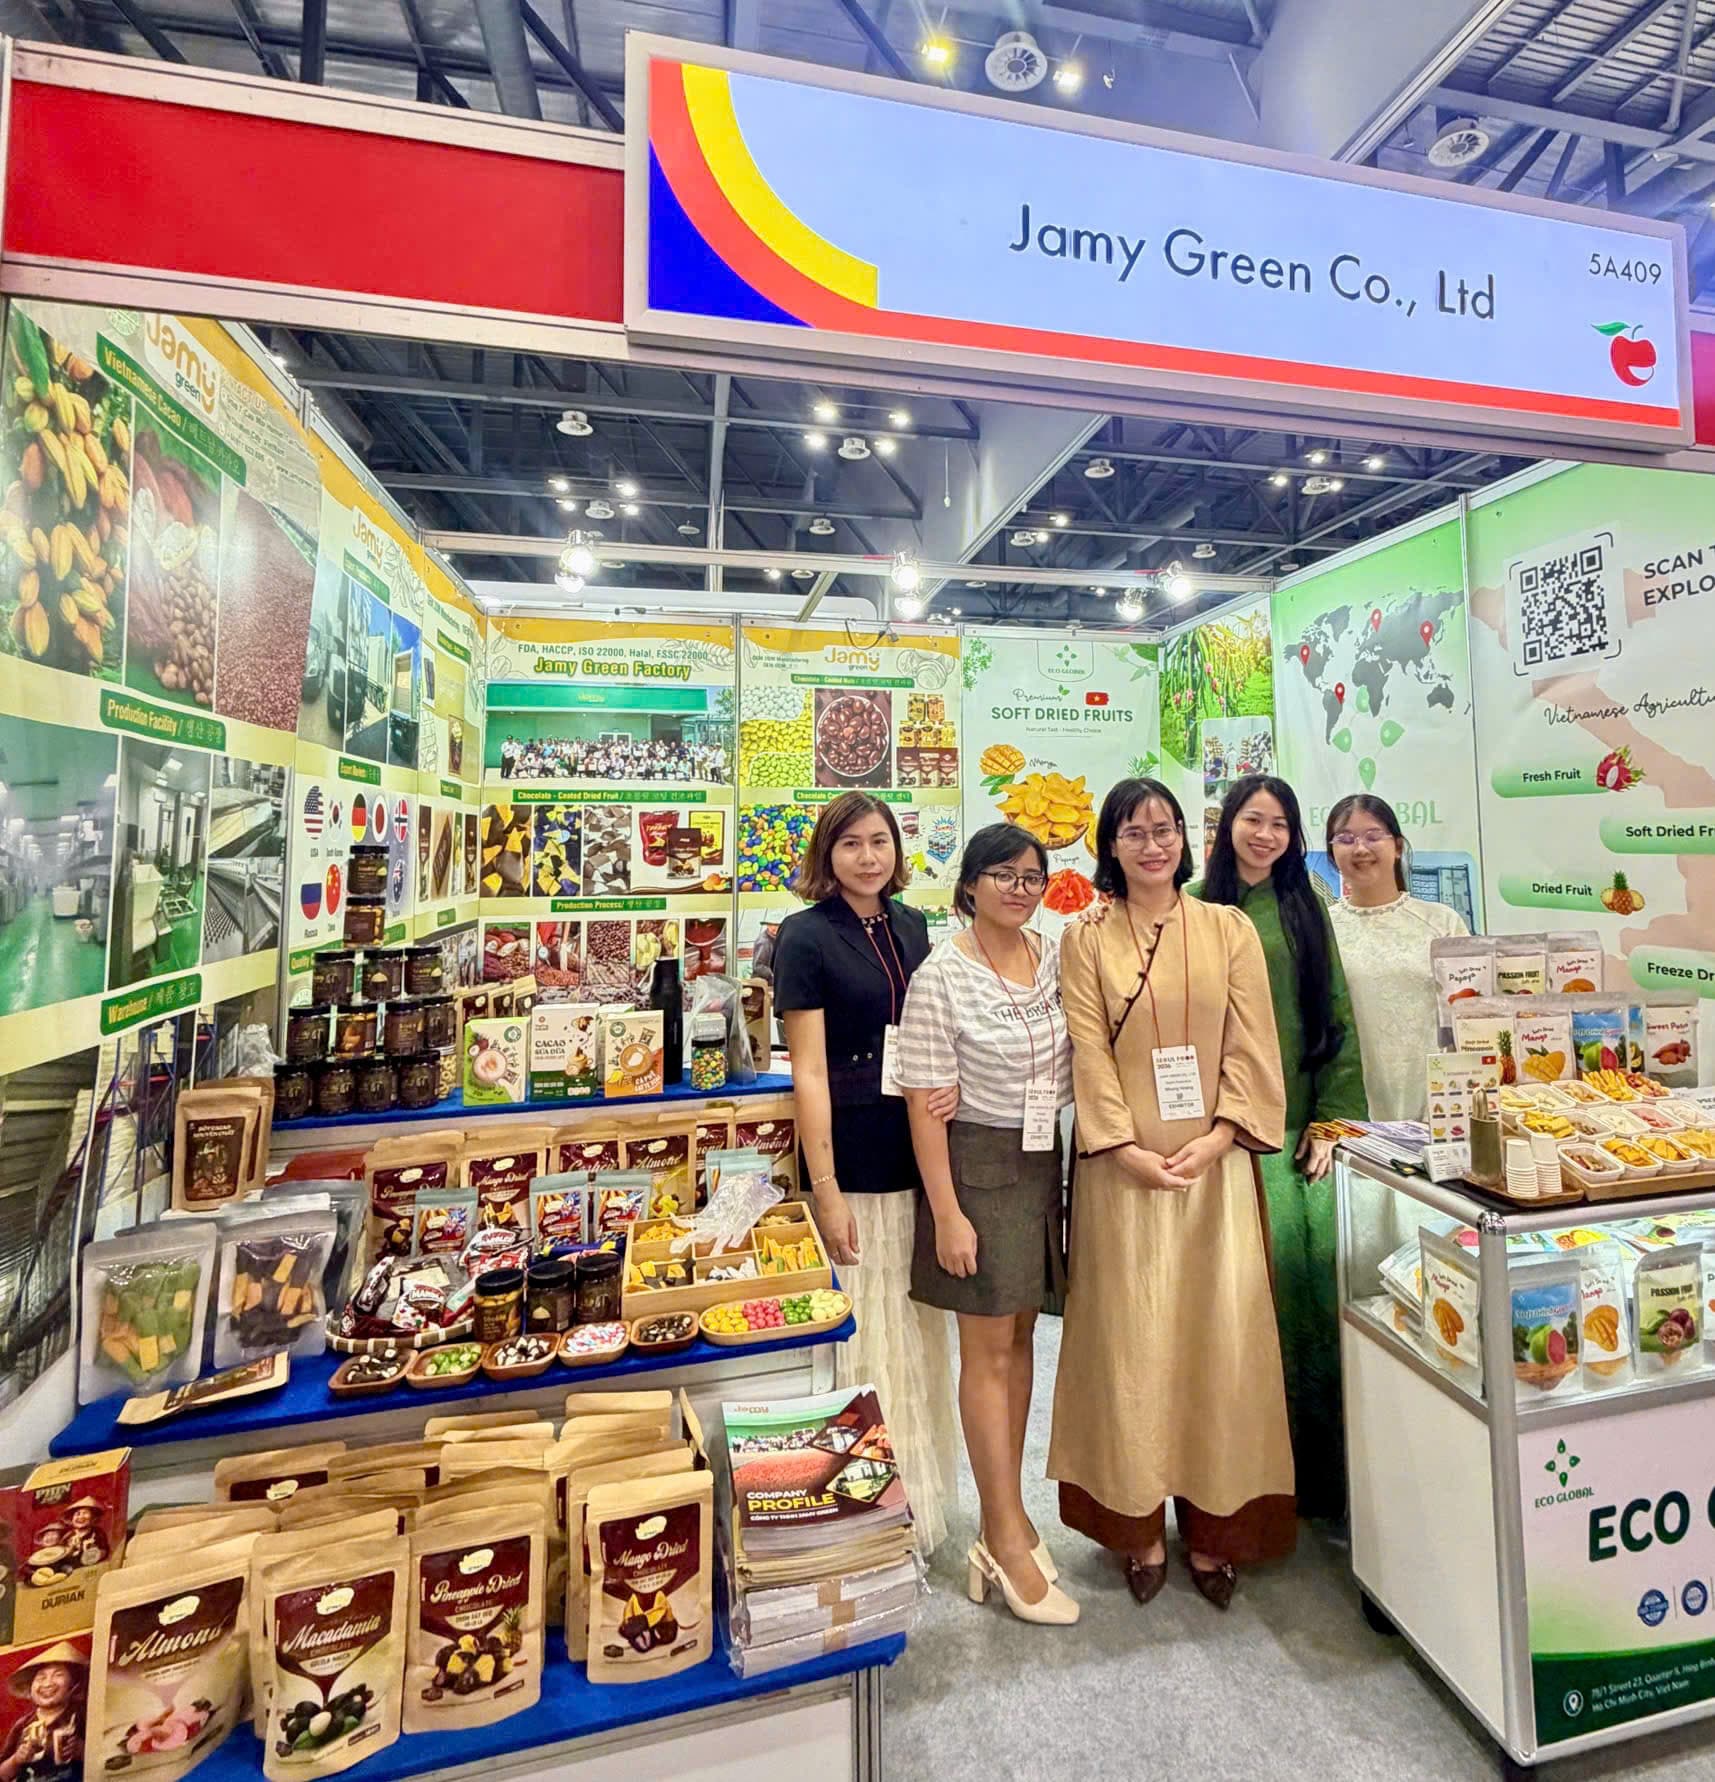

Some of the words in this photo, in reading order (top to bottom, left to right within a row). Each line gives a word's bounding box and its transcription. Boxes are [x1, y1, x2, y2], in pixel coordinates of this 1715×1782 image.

[1009, 203, 1146, 283] Jamy
[1163, 228, 1312, 293] Green
[1329, 254, 1417, 317] Co.,
[1437, 269, 1496, 319] Ltd
[1589, 253, 1662, 285] 5A409
[146, 312, 216, 414] Jamy
[175, 371, 202, 403] green
[352, 513, 384, 570] Jamy
[1643, 548, 1704, 580] SCAN
[518, 643, 540, 654] FDA,
[541, 644, 576, 657] HACCP,
[596, 646, 626, 658] 22000,
[656, 649, 679, 660] FSSC
[681, 651, 708, 661] 22000
[825, 648, 880, 672] Jamy
[534, 657, 577, 677] Jamy
[582, 659, 629, 676] Green
[633, 661, 691, 681] Factory
[848, 664, 868, 672] green
[106, 698, 148, 728] Production
[148, 711, 178, 737] Facility
[991, 706, 1031, 720] SOFT
[1035, 707, 1080, 721] DRIED
[1084, 709, 1133, 722] FRUITS
[1543, 703, 1629, 725] Vietnamese
[1522, 771, 1552, 784] Fresh
[1554, 768, 1582, 781] Fruit
[517, 791, 552, 800] Chocolate
[558, 792, 582, 800] Coated
[583, 792, 602, 800] Dried
[602, 792, 619, 800] Fruit
[796, 792, 826, 800] Chocolate
[1396, 801, 1444, 827] BAL
[1625, 825, 1653, 838] Soft
[1656, 825, 1695, 838] Dried
[1532, 882, 1563, 895] Dried
[1565, 884, 1593, 897] Fruit
[556, 902, 593, 910] Production
[1448, 972, 1477, 984] Papaya
[1497, 971, 1524, 979] PASSION
[1556, 964, 1582, 975] Mango
[1646, 961, 1694, 979] Freeze
[992, 1007, 1025, 1022] THE
[535, 1039, 566, 1048] CACAO
[1521, 1033, 1548, 1042] Mango
[747, 1136, 792, 1151] Almond
[636, 1153, 684, 1169] Almond
[477, 1174, 505, 1189] Mango
[505, 1171, 530, 1184] Dried
[1650, 1286, 1680, 1298] PASSION
[746, 1489, 808, 1499] COMPANY
[748, 1492, 836, 1512] PROFILE
[1534, 1495, 1555, 1509] ECO
[1556, 1486, 1595, 1503] GLOBAL
[1588, 1490, 1691, 1563] ECO
[612, 1549, 652, 1570] Mango
[653, 1538, 689, 1560] Dried
[429, 1579, 485, 1604] Pineapple
[485, 1570, 524, 1594] Dried
[41, 1590, 86, 1611] DURIAN
[118, 1617, 229, 1667] Almond
[281, 1615, 382, 1654] Macadamia
[1608, 1681, 1632, 1694] Street
[1644, 1670, 1674, 1685] Quarter
[1604, 1699, 1617, 1710] Chi
[1618, 1692, 1638, 1705] Minh
[1671, 1679, 1690, 1690] Nam
